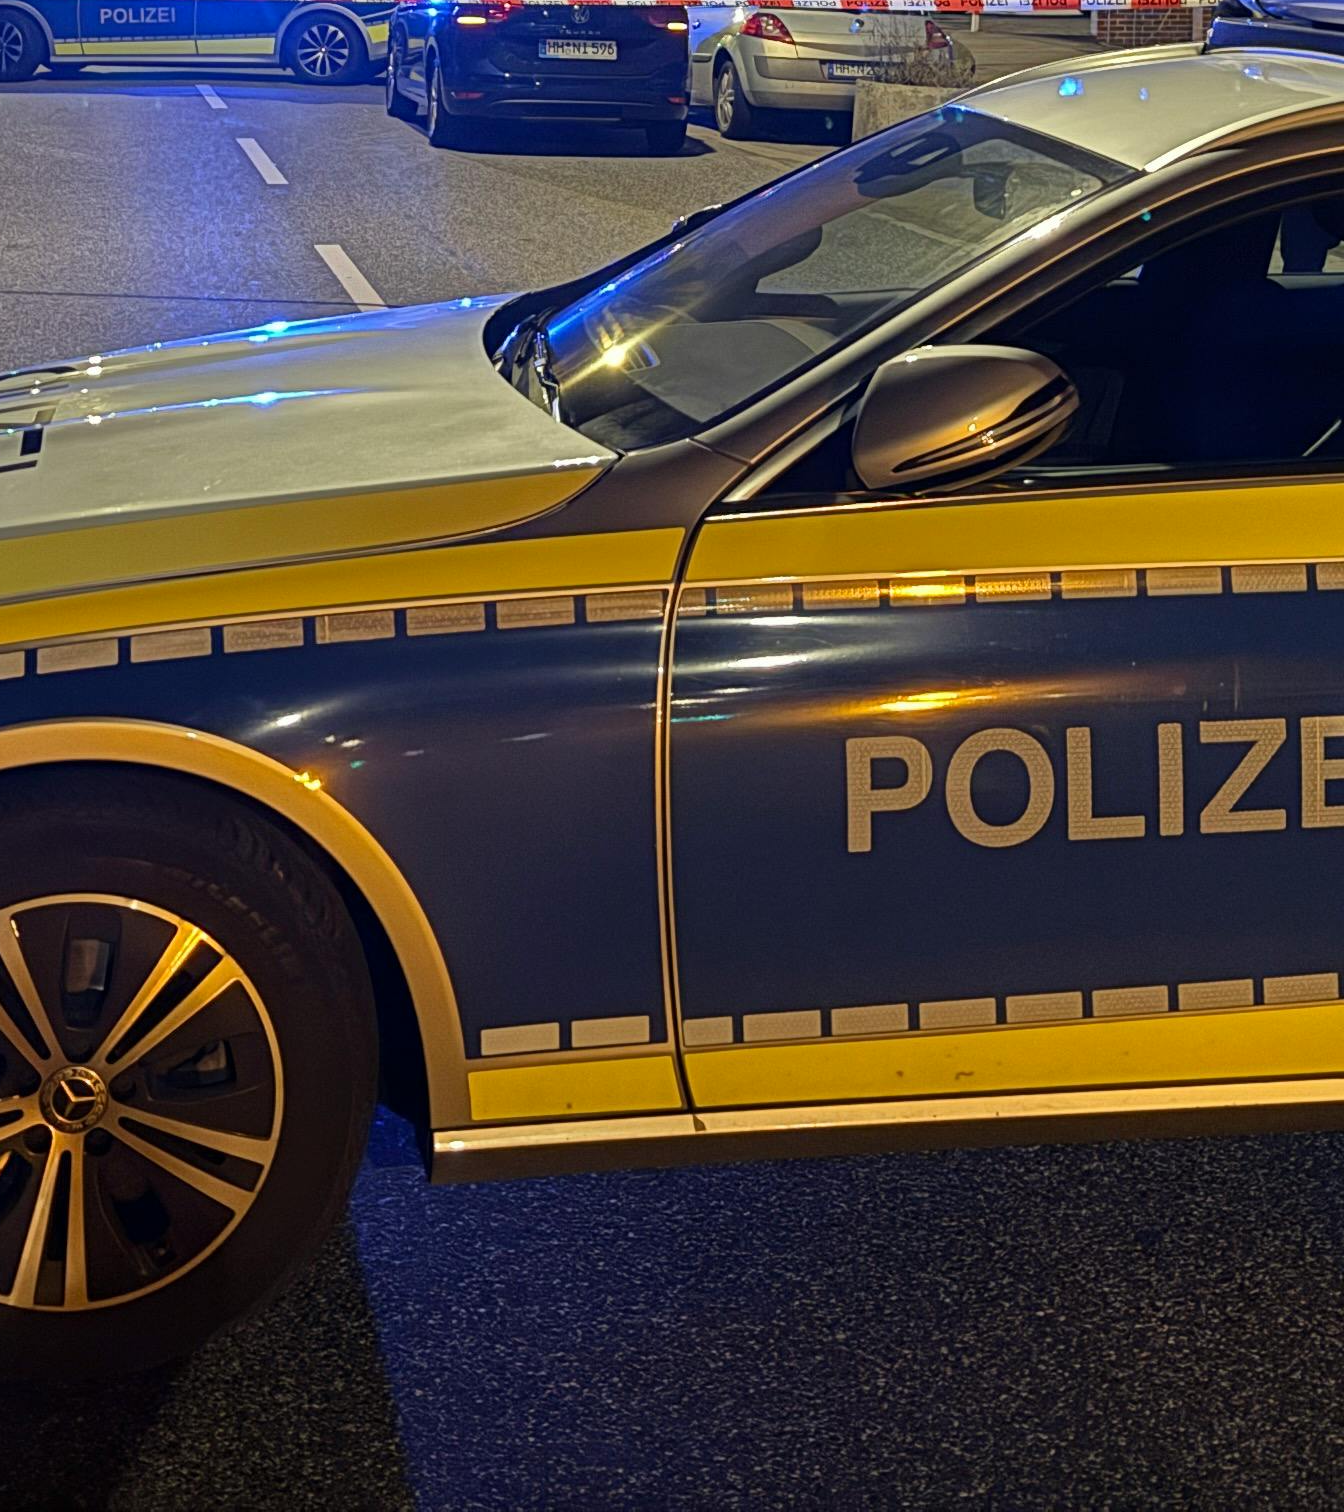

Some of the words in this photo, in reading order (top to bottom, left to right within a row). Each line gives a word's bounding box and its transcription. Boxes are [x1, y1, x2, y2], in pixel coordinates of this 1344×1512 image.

[960, 0, 1008, 7] POLIZEI
[100, 7, 175, 24] POLIZEI
[548, 41, 565, 54] HH
[572, 42, 589, 54] NI
[592, 42, 615, 56] 596
